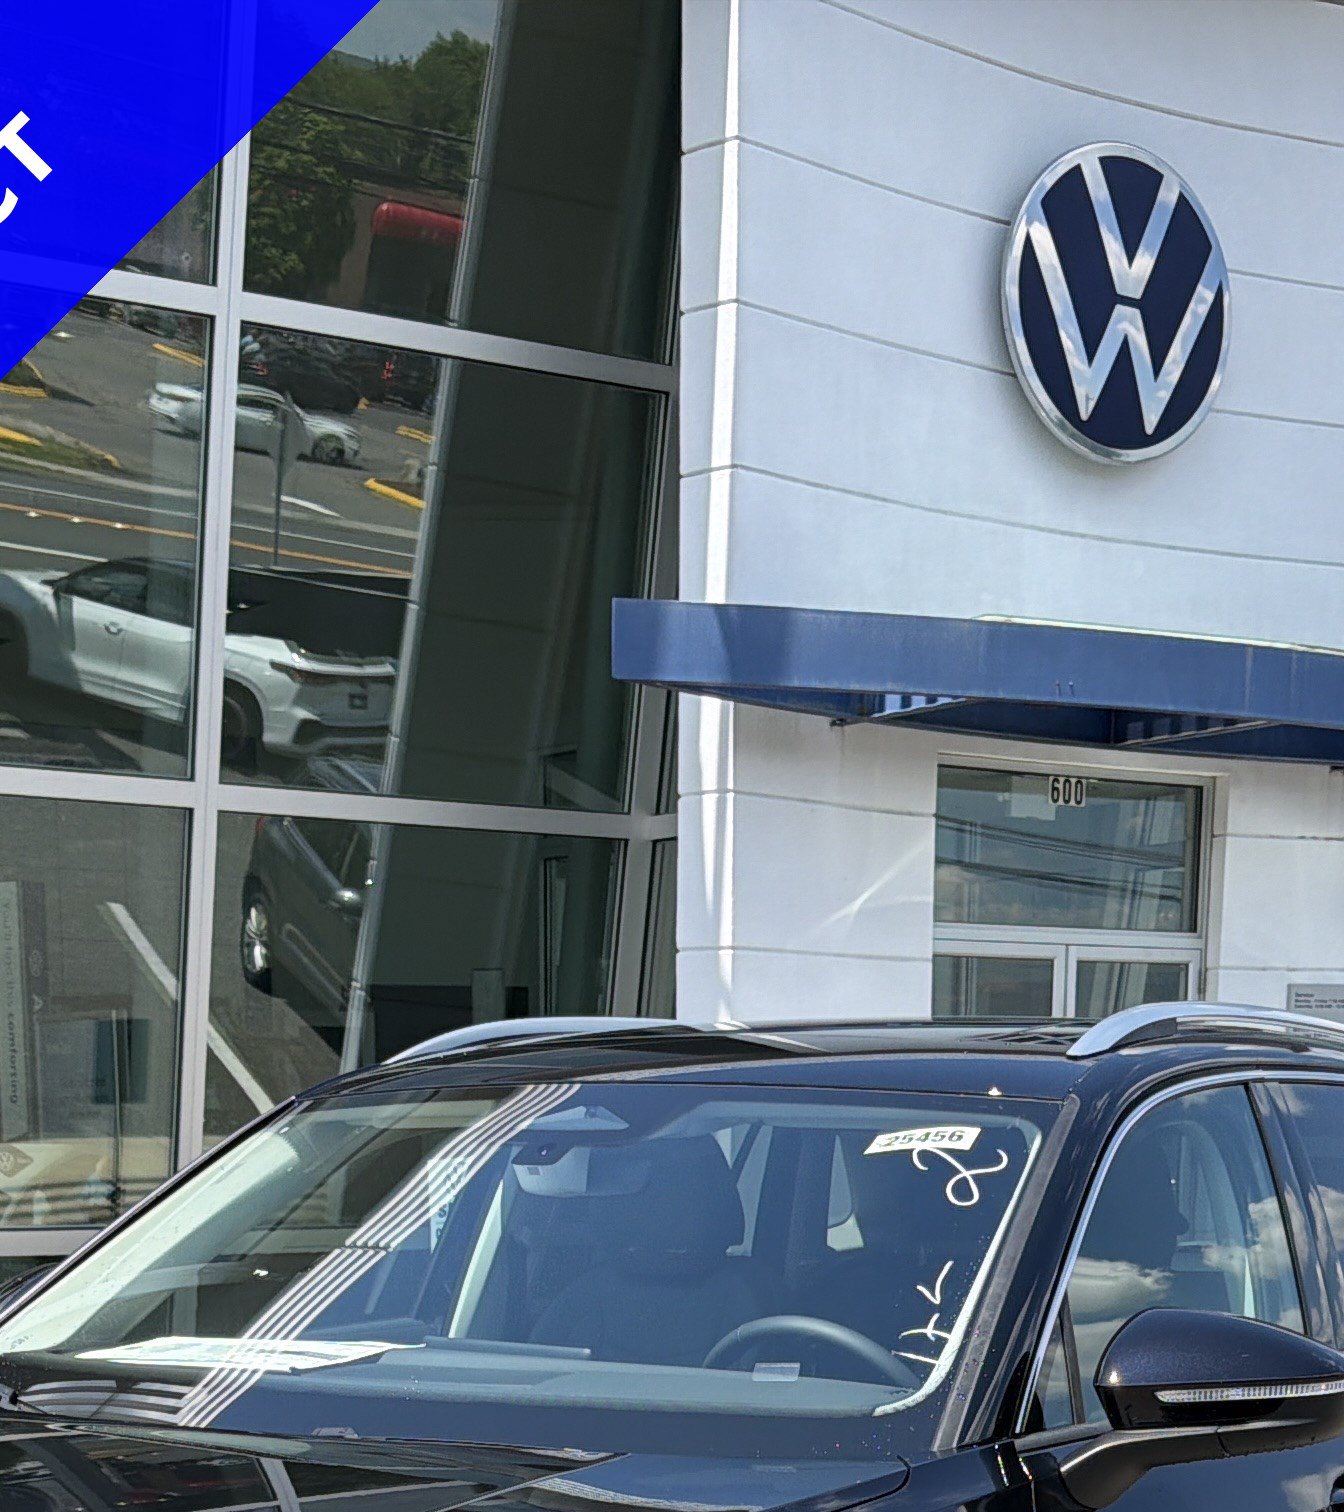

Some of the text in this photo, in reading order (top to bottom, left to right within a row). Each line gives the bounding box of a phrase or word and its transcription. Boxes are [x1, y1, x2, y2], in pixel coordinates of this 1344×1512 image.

[1051, 777, 1084, 805] 600
[7, 1012, 19, 1104] comforting
[878, 1130, 966, 1147] 25456
